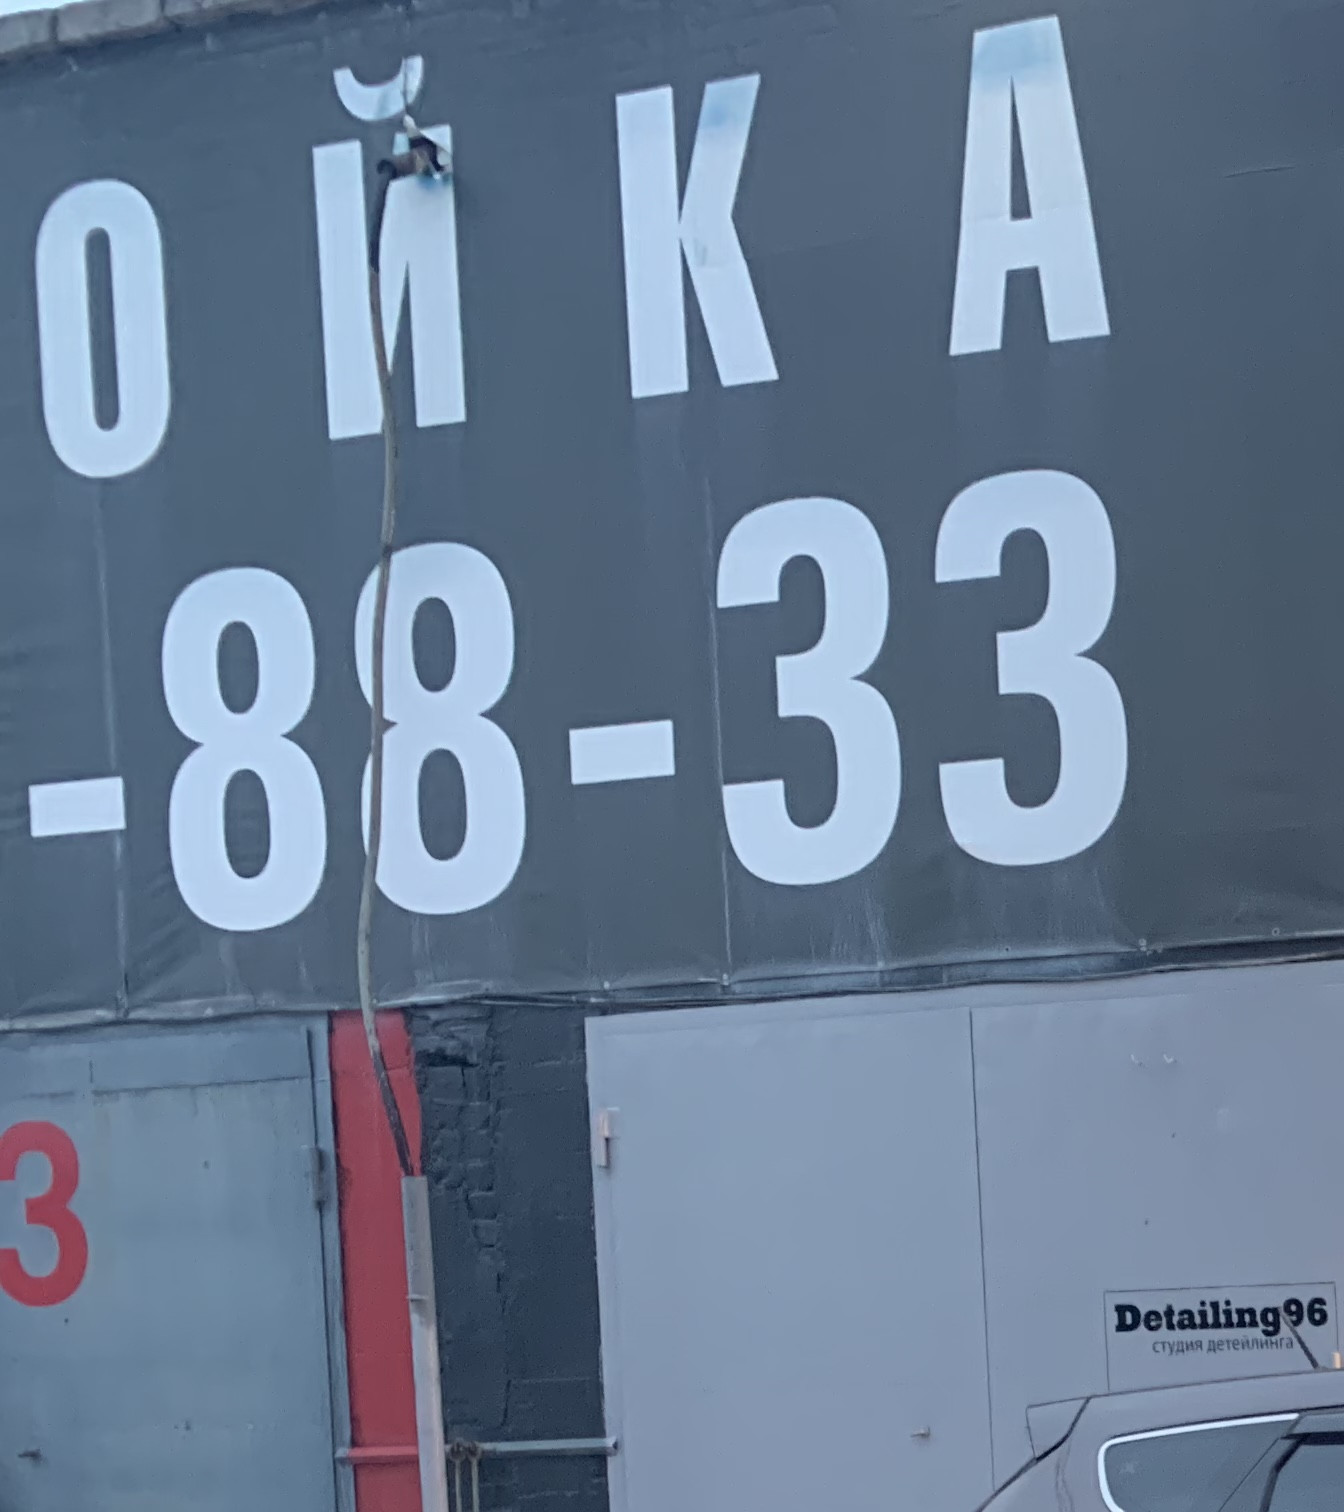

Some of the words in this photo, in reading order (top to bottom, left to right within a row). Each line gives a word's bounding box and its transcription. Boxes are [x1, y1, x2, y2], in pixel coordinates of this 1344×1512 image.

[0, 1121, 89, 1307] 3
[1114, 1297, 1328, 1337] Detailing96
[1152, 1338, 1202, 1355] студия
[1206, 1336, 1294, 1353] детейлинга
